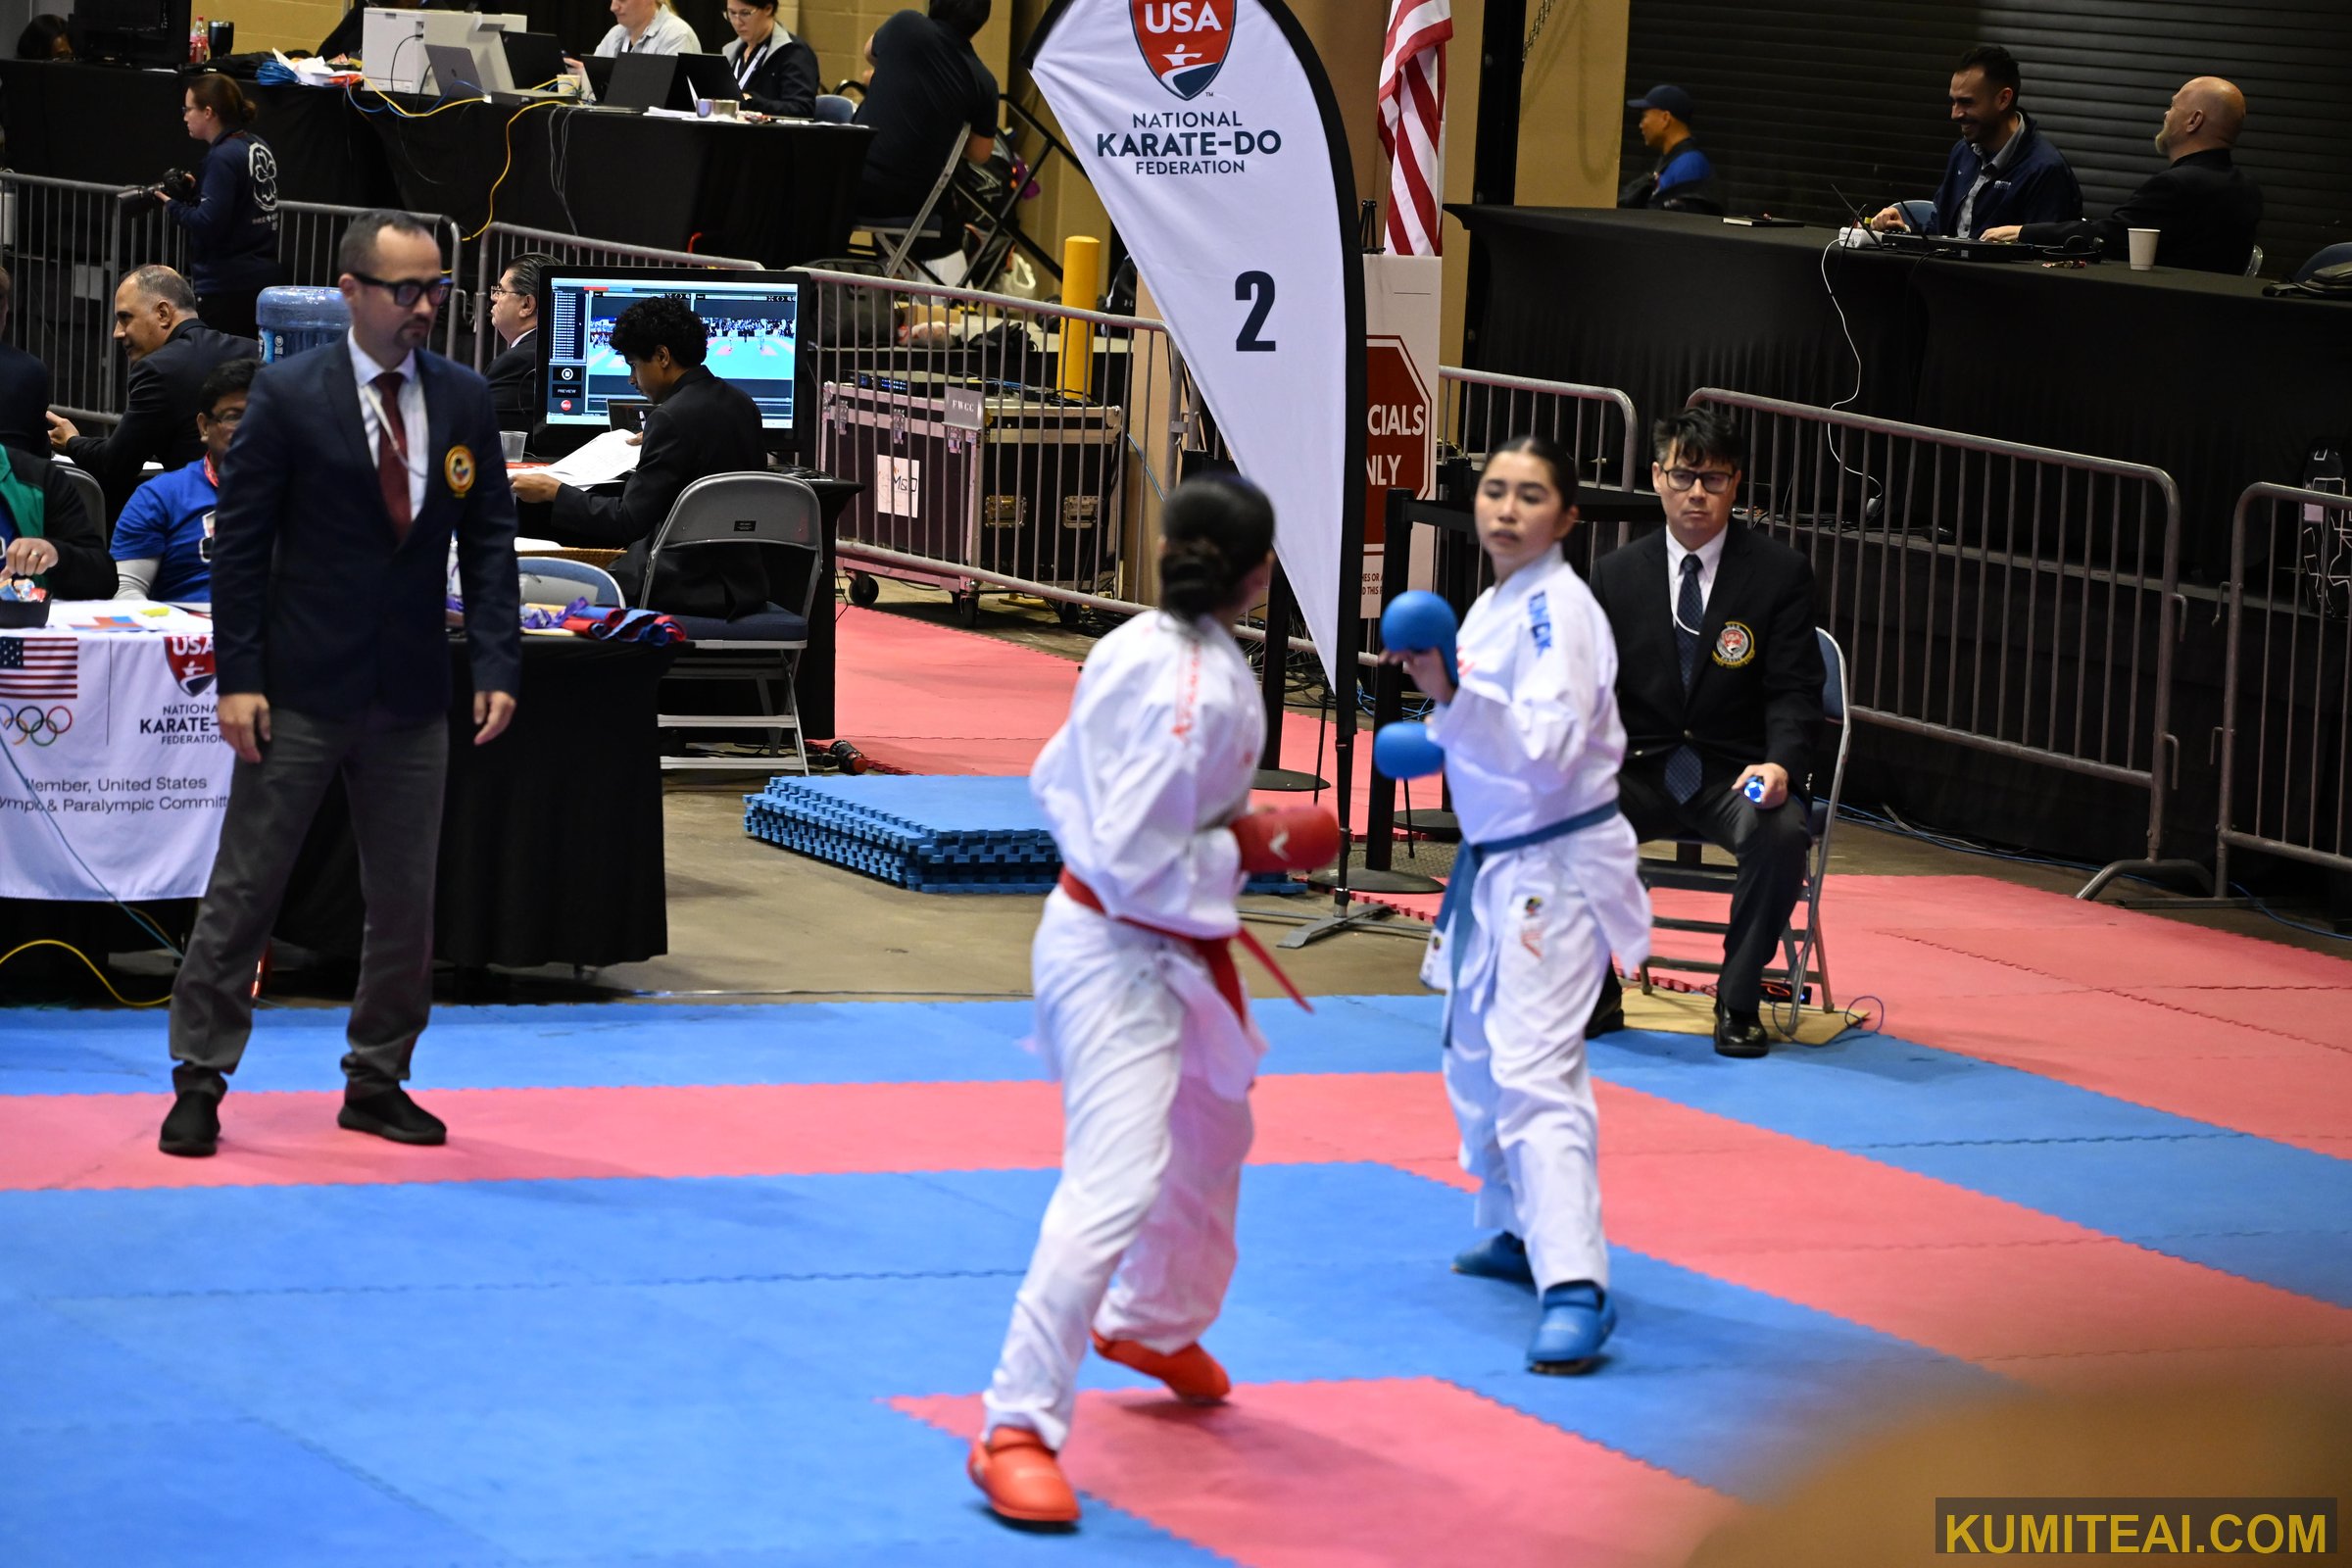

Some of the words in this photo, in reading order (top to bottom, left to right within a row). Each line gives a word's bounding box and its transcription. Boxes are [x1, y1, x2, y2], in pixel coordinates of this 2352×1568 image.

[1145, 1, 1223, 34] USA
[1133, 111, 1243, 128] NATIONAL
[1097, 129, 1282, 157] KARATE-DO
[1136, 160, 1246, 174] FEDERATION
[1235, 270, 1276, 352] 2
[1367, 404, 1425, 436] CIALS
[1366, 455, 1402, 486] NLY
[1371, 572, 1380, 582] OR
[1367, 586, 1379, 595] THIS
[172, 636, 214, 656] USA
[163, 704, 219, 716] NATIONA
[140, 716, 220, 734] KARATE-
[98, 777, 152, 792] United
[156, 776, 208, 790] States
[47, 798, 58, 812] &
[63, 797, 154, 814] Paralympic
[159, 795, 227, 810] Committ
